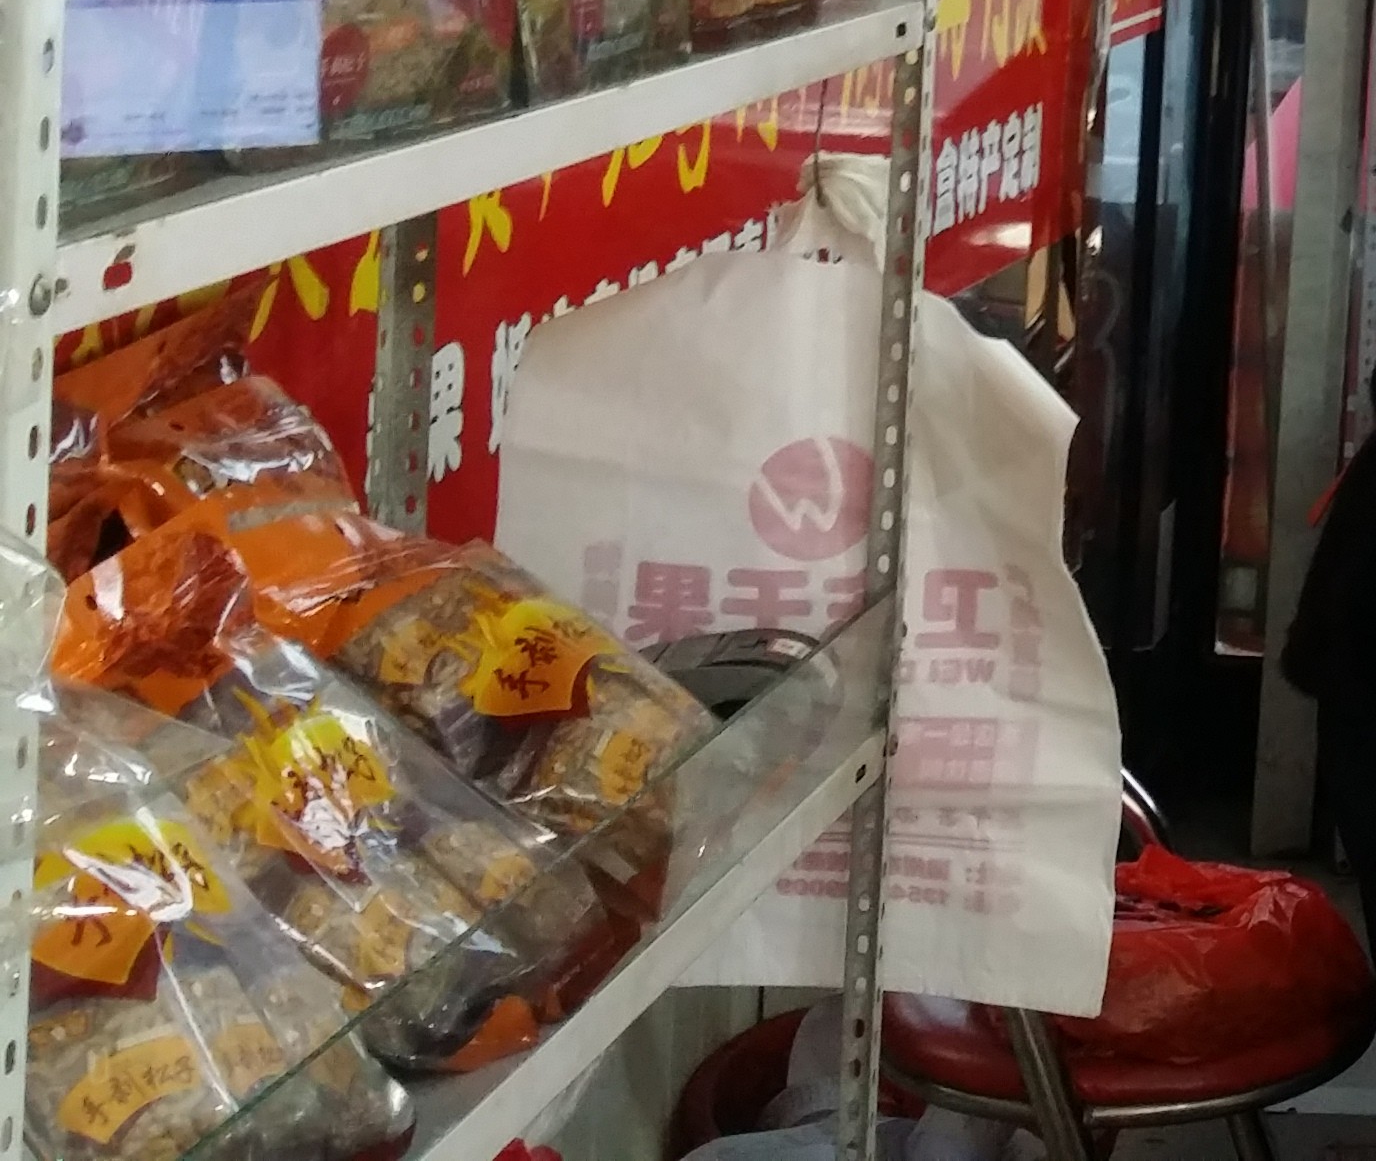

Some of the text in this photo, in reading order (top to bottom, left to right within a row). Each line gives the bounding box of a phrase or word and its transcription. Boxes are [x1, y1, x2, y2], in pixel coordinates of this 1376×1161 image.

[934, 102, 1043, 235] 盒特产定制
